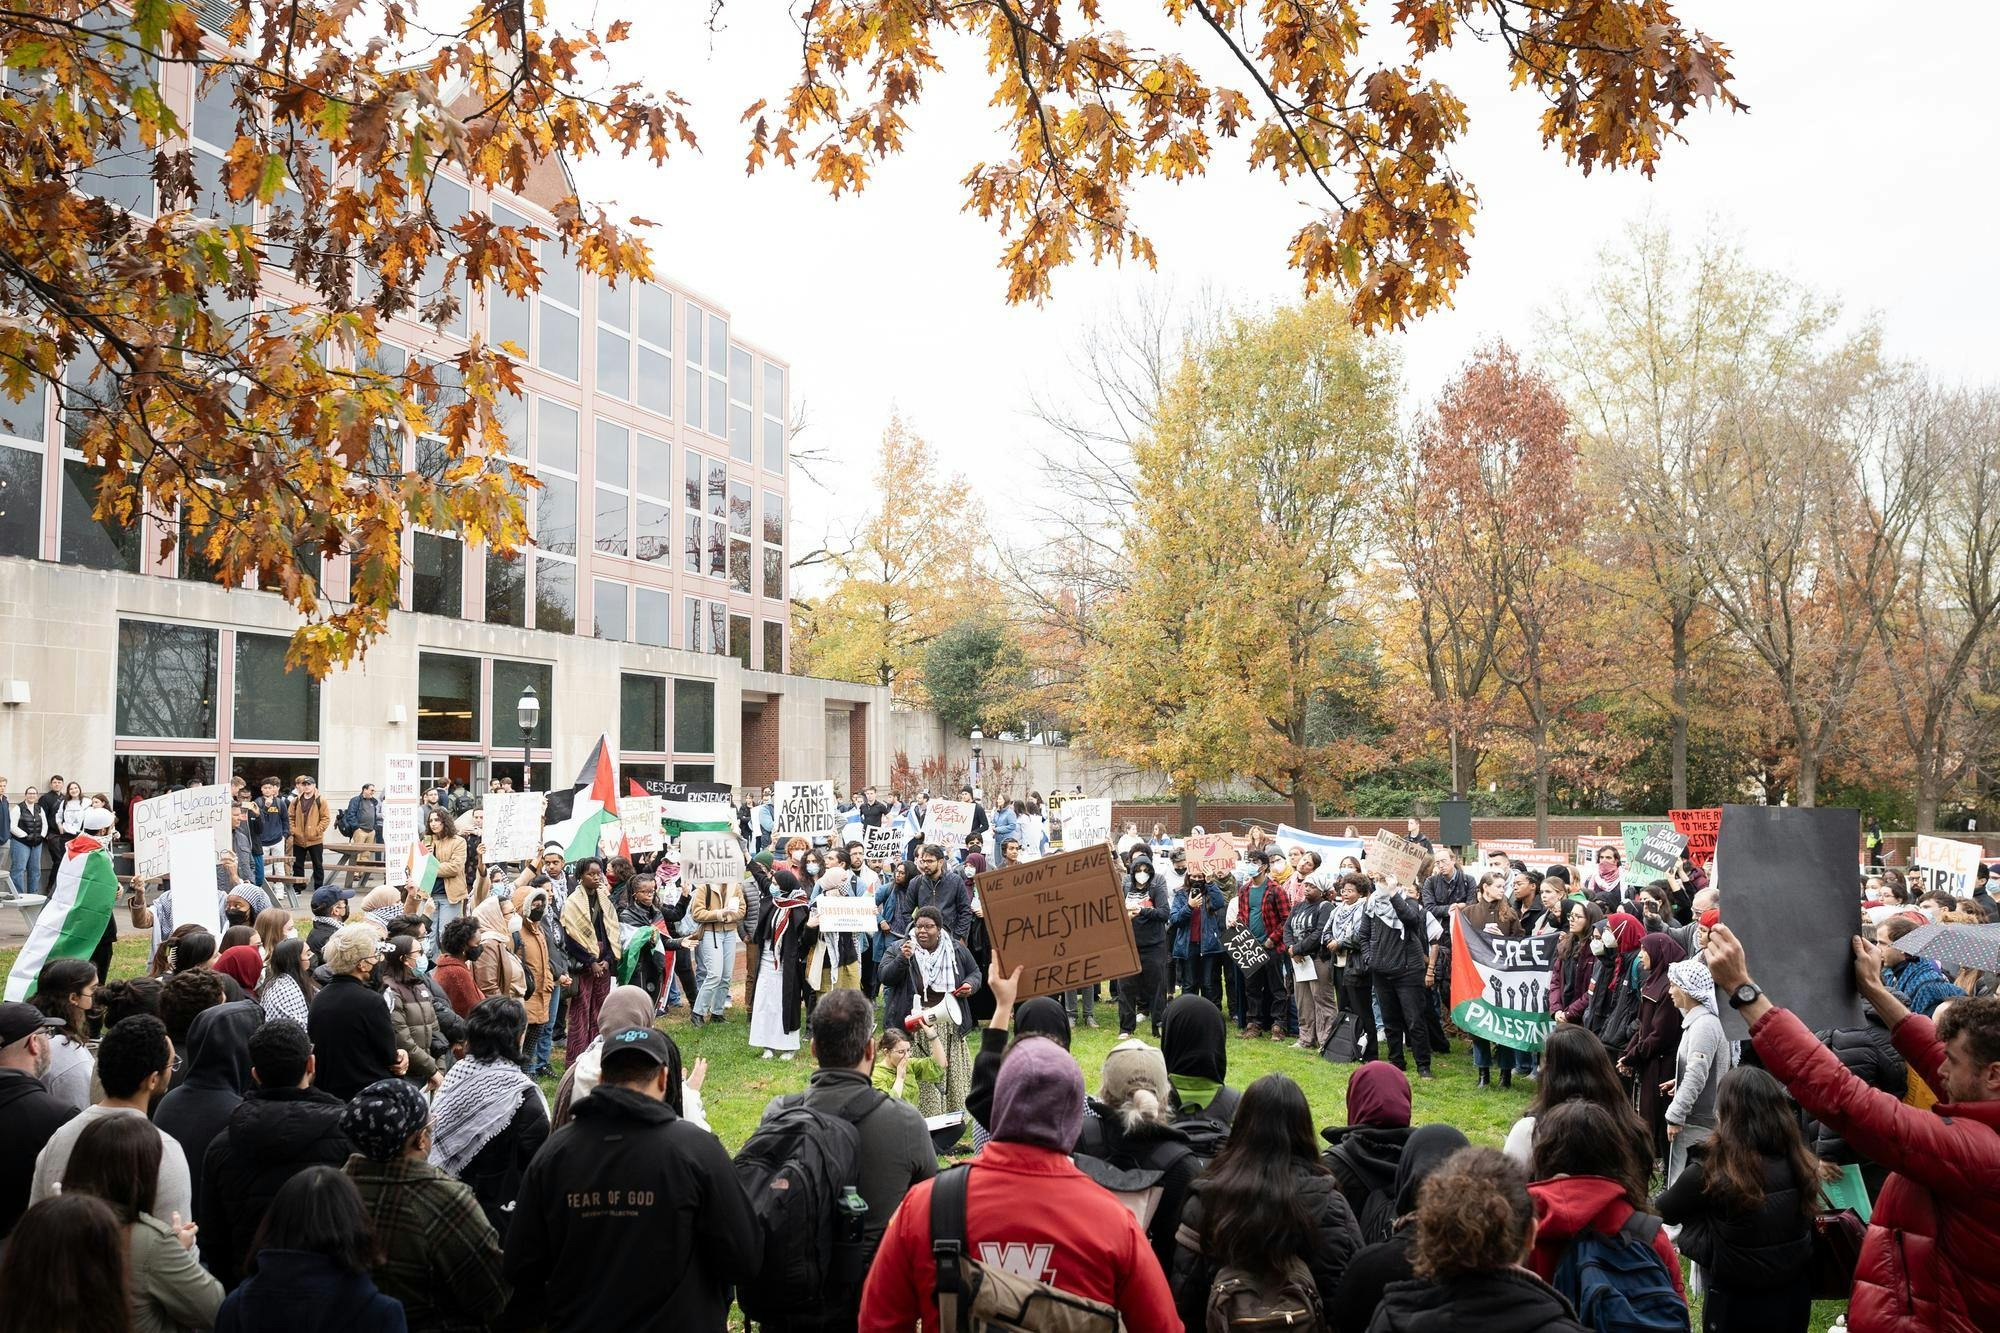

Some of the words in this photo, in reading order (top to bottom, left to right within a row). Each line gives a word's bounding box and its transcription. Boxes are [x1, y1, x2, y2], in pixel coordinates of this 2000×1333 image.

[389, 759, 413, 769] PRINCETON
[397, 772, 405, 781] FOR
[389, 784, 413, 794] PALESTINE
[646, 781, 687, 795] RESPECT
[792, 784, 824, 798] JEWS
[687, 792, 730, 803] EXISTENCE
[136, 797, 168, 824] ONE
[173, 786, 230, 813] Holocaust
[389, 807, 399, 816] THEY
[781, 797, 829, 814] AGAINST
[929, 804, 959, 815] NEVER
[1071, 804, 1101, 817] WHERE
[777, 813, 833, 832] APARTEID
[935, 813, 968, 825] AGAIN
[1082, 817, 1091, 828] IS
[1672, 811, 1694, 822] FROM
[1695, 811, 1711, 821] THE
[139, 825, 163, 842] Does
[164, 815, 182, 832] Not
[184, 808, 224, 827] Justify
[389, 820, 395, 829] TO
[1681, 823, 1691, 832] TO
[1692, 822, 1708, 831] THE
[1709, 822, 1719, 831] SE
[389, 833, 399, 842] THEY
[868, 828, 891, 841] END
[1069, 826, 1109, 840] HUMANITY
[1656, 829, 1681, 844] END
[698, 839, 733, 861] FREE
[866, 840, 890, 851] SEIGE
[890, 840, 901, 851] ON
[1187, 836, 1211, 850] FREE
[1377, 829, 1403, 850] NEVER
[1402, 841, 1427, 861] AGAIN
[1643, 835, 1683, 858] OCCUPATION
[865, 850, 889, 859] GAZA
[1508, 853, 1565, 862] IDNAPPED
[1643, 850, 1670, 868] NOW
[138, 854, 163, 879] FREE
[687, 861, 737, 880] PALESTINE
[985, 877, 1003, 893] WE
[1013, 863, 1057, 887] WON'T
[1065, 852, 1108, 876] LEAVE
[1034, 891, 1064, 905] TILL
[1002, 894, 1119, 951] PALESTINE
[1053, 942, 1066, 957] IS
[1235, 921, 1268, 964] CEASE
[1223, 941, 1250, 970] NOW
[1231, 935, 1257, 967] FIRE
[1491, 938, 1550, 967] FREE
[1033, 955, 1103, 993] FREE
[567, 1190, 601, 1208] FEAR
[607, 1189, 620, 1205] OF
[627, 1189, 657, 1207] GOD
